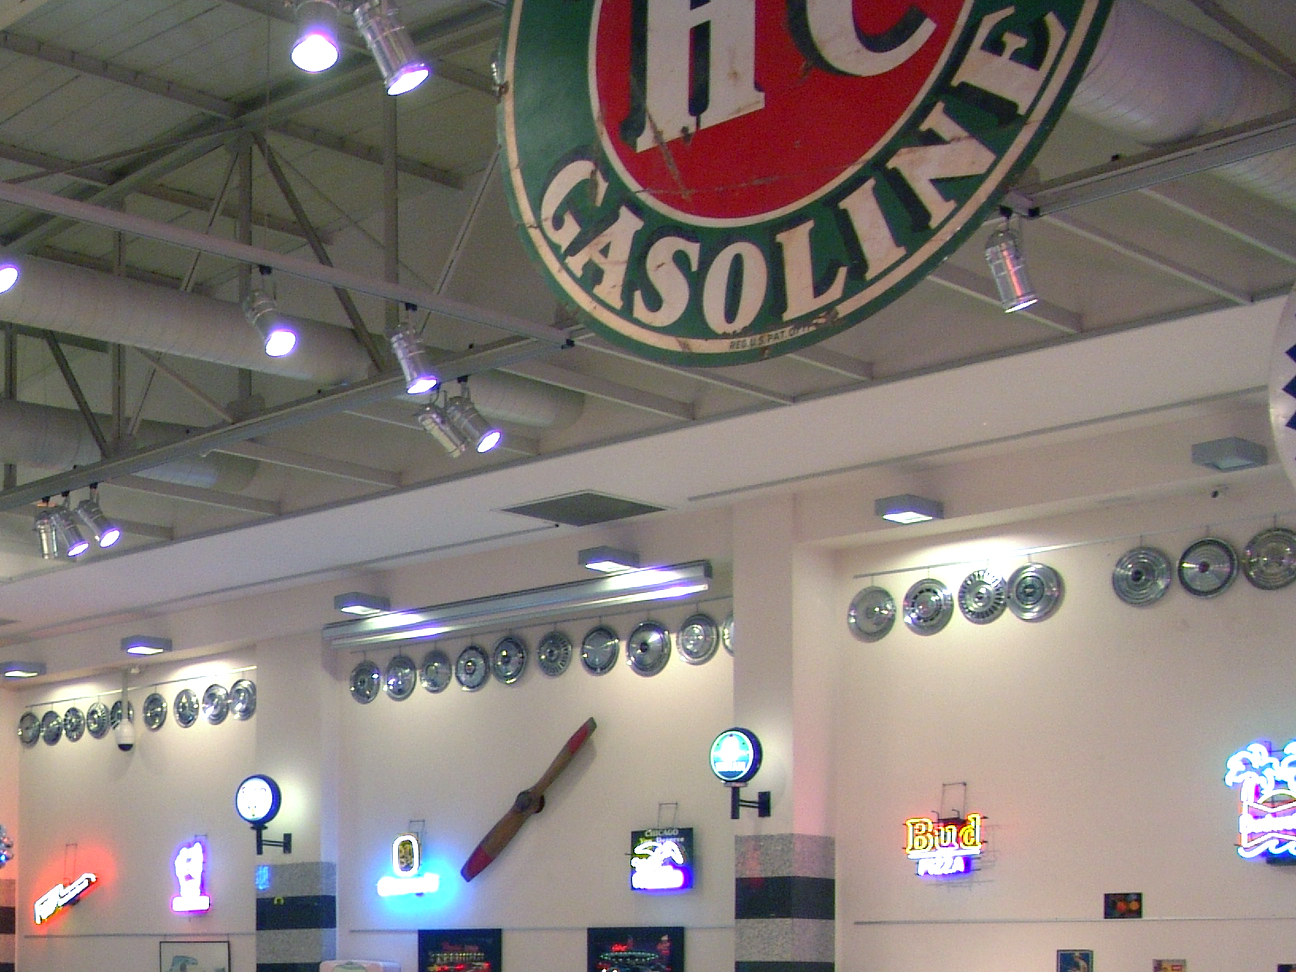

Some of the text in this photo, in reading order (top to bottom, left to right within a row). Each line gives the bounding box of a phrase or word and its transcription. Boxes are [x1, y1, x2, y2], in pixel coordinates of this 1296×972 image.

[541, 6, 1066, 335] GASOLINE
[644, 828, 679, 838] CHICAGO
[905, 812, 982, 855] Bud
